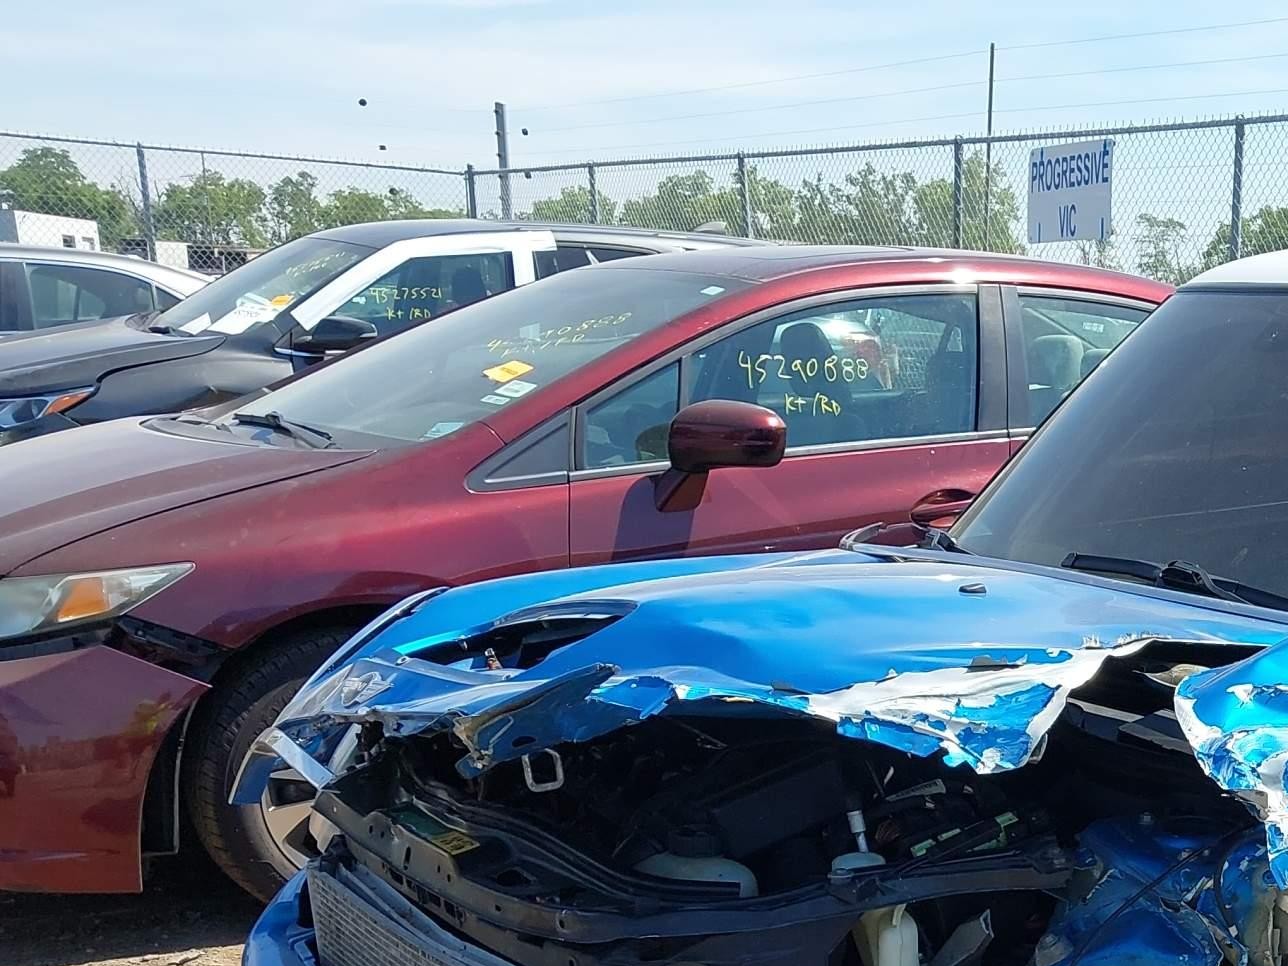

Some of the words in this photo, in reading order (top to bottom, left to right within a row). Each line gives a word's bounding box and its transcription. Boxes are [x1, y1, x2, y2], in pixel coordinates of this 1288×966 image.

[1031, 150, 1109, 192] PROGRESSIVE
[1059, 204, 1077, 237] VIC
[369, 287, 442, 304] 45275521
[738, 351, 868, 389] 45290888
